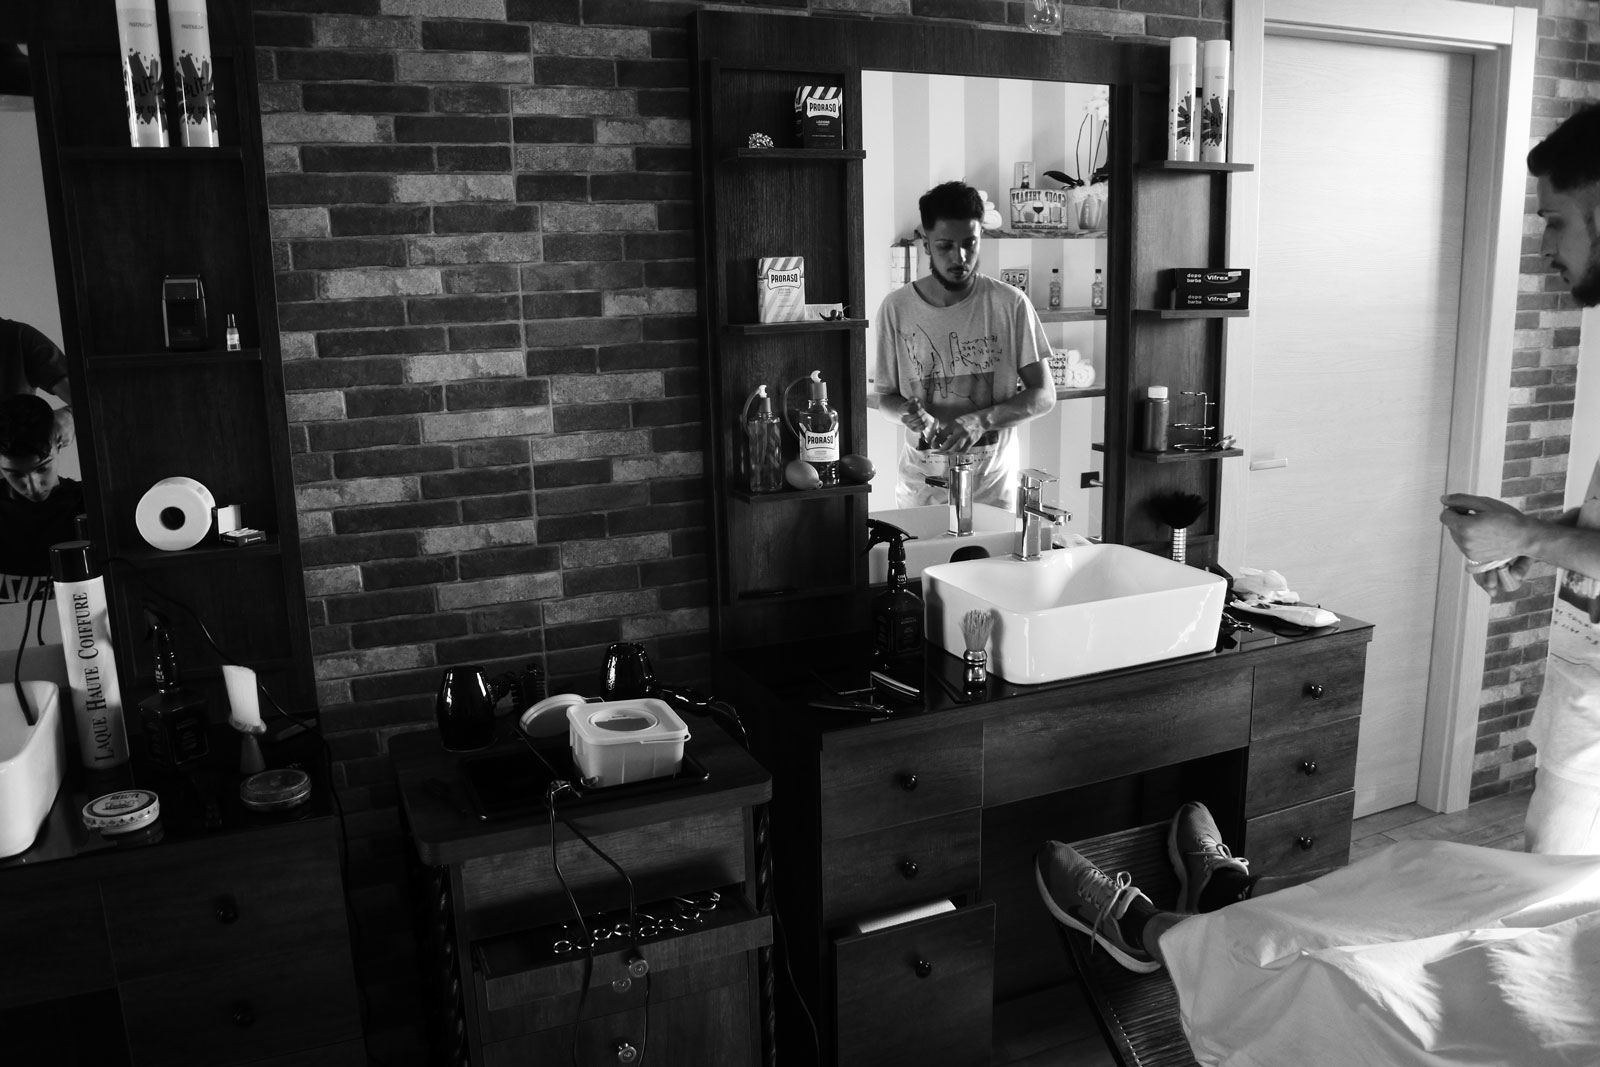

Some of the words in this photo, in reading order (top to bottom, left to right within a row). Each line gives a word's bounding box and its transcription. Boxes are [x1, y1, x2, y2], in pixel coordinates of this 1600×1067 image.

[809, 102, 837, 113] PRORASO
[770, 273, 798, 284] PRORASO
[807, 435, 834, 445] PRORASO
[72, 592, 99, 660] COIFFURE
[84, 666, 107, 712] HAUTE
[93, 716, 115, 762] LAQUE
